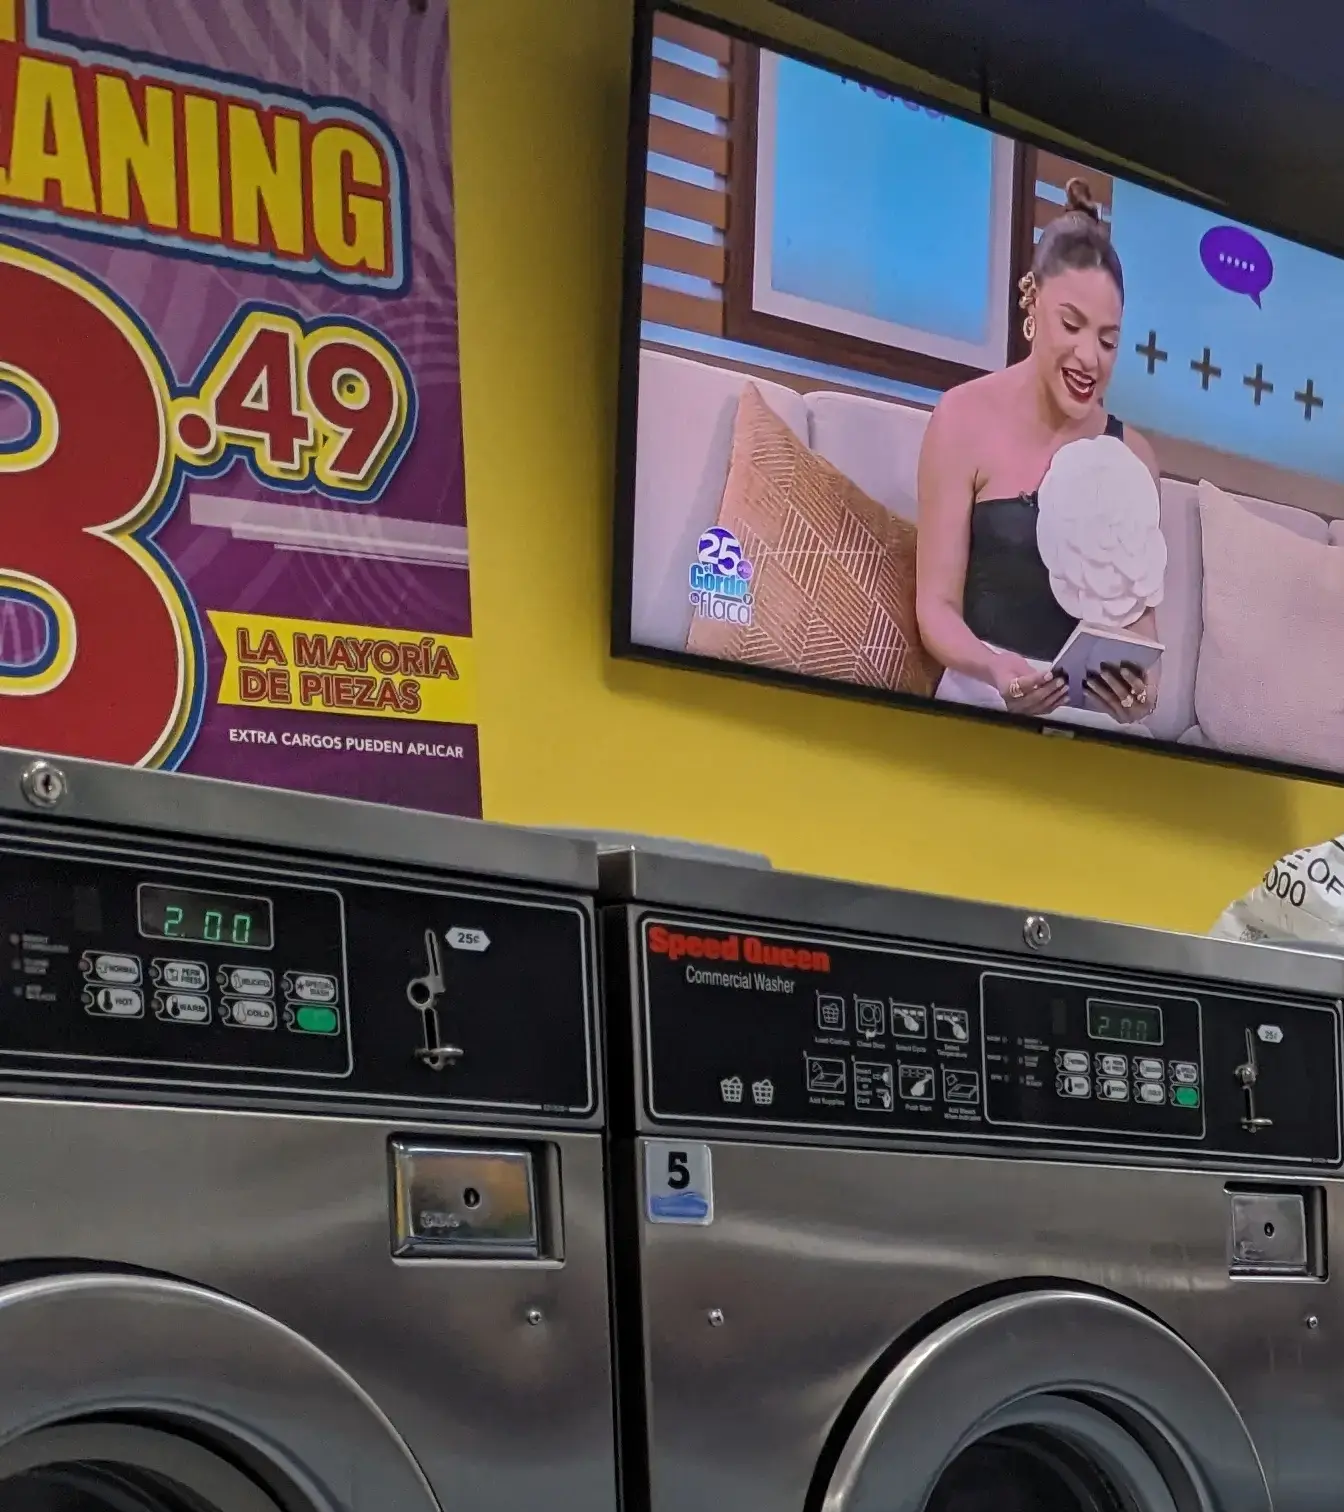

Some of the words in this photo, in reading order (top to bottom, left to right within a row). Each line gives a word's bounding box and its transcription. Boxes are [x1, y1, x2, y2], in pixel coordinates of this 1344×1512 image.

[0, 56, 391, 270] ANING
[698, 533, 741, 576] 25
[690, 564, 747, 596] Gordo
[238, 628, 287, 664] LA
[293, 633, 459, 680] MAYORÍA
[239, 666, 291, 703] DE
[300, 672, 421, 713] PIEZAS
[229, 728, 277, 745] EXTRA
[282, 732, 341, 750] CARGOS
[346, 737, 403, 754] PUEDEN
[407, 742, 464, 758] APLICAR
[649, 926, 739, 962] Speed
[743, 936, 831, 973] Queen
[686, 964, 752, 989] Commercial
[754, 972, 796, 994] Washer
[667, 1152, 690, 1190] 5
